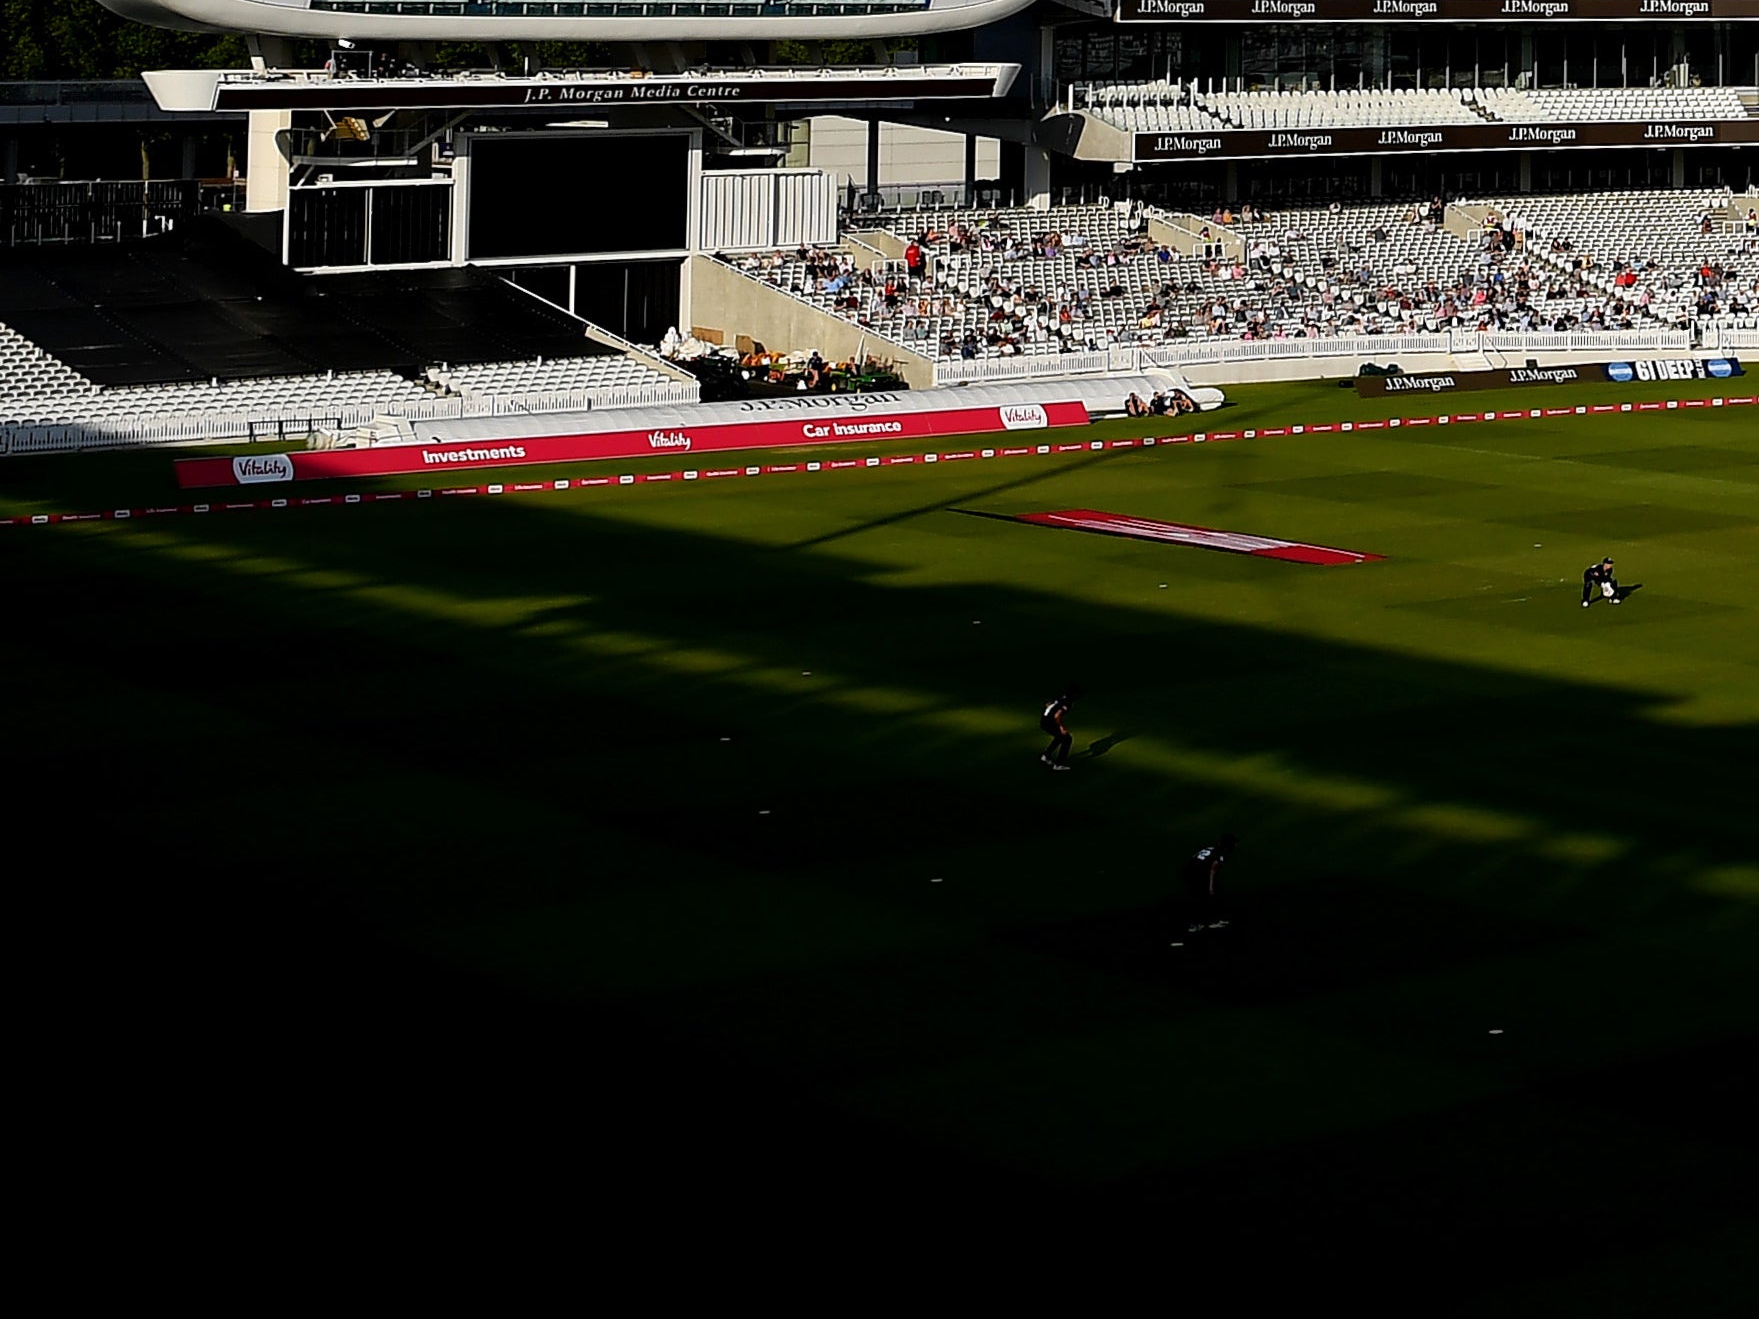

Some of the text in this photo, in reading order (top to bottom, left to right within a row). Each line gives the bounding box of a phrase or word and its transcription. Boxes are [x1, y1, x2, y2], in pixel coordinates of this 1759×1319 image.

[1138, 0, 1204, 17] J.P.Morgan
[1251, 0, 1315, 17] J.P.Morgan
[1373, 0, 1437, 17] J.P.Morgan
[1501, 0, 1568, 17] J.P.Morgan
[1639, 0, 1709, 17] J.P.Morgan
[525, 86, 740, 103] J.P. Morgan Media Centre
[1268, 132, 1332, 150] J.P.Morgan
[1377, 129, 1443, 147] J.P.Morgan
[1508, 127, 1576, 145] J.P.Morgan
[1644, 124, 1713, 142] J.P.Morgan
[1154, 136, 1221, 154] J.P.Morgan
[1509, 368, 1578, 384] J.P.Morgan
[1656, 359, 1695, 380] DEEP
[1385, 376, 1454, 392] J.P.Morgan
[1004, 408, 1043, 425] Vitality
[803, 420, 902, 438] Car Insurance
[647, 432, 692, 450] Vitality
[422, 446, 526, 463] Investments
[237, 458, 288, 478] Vitality
